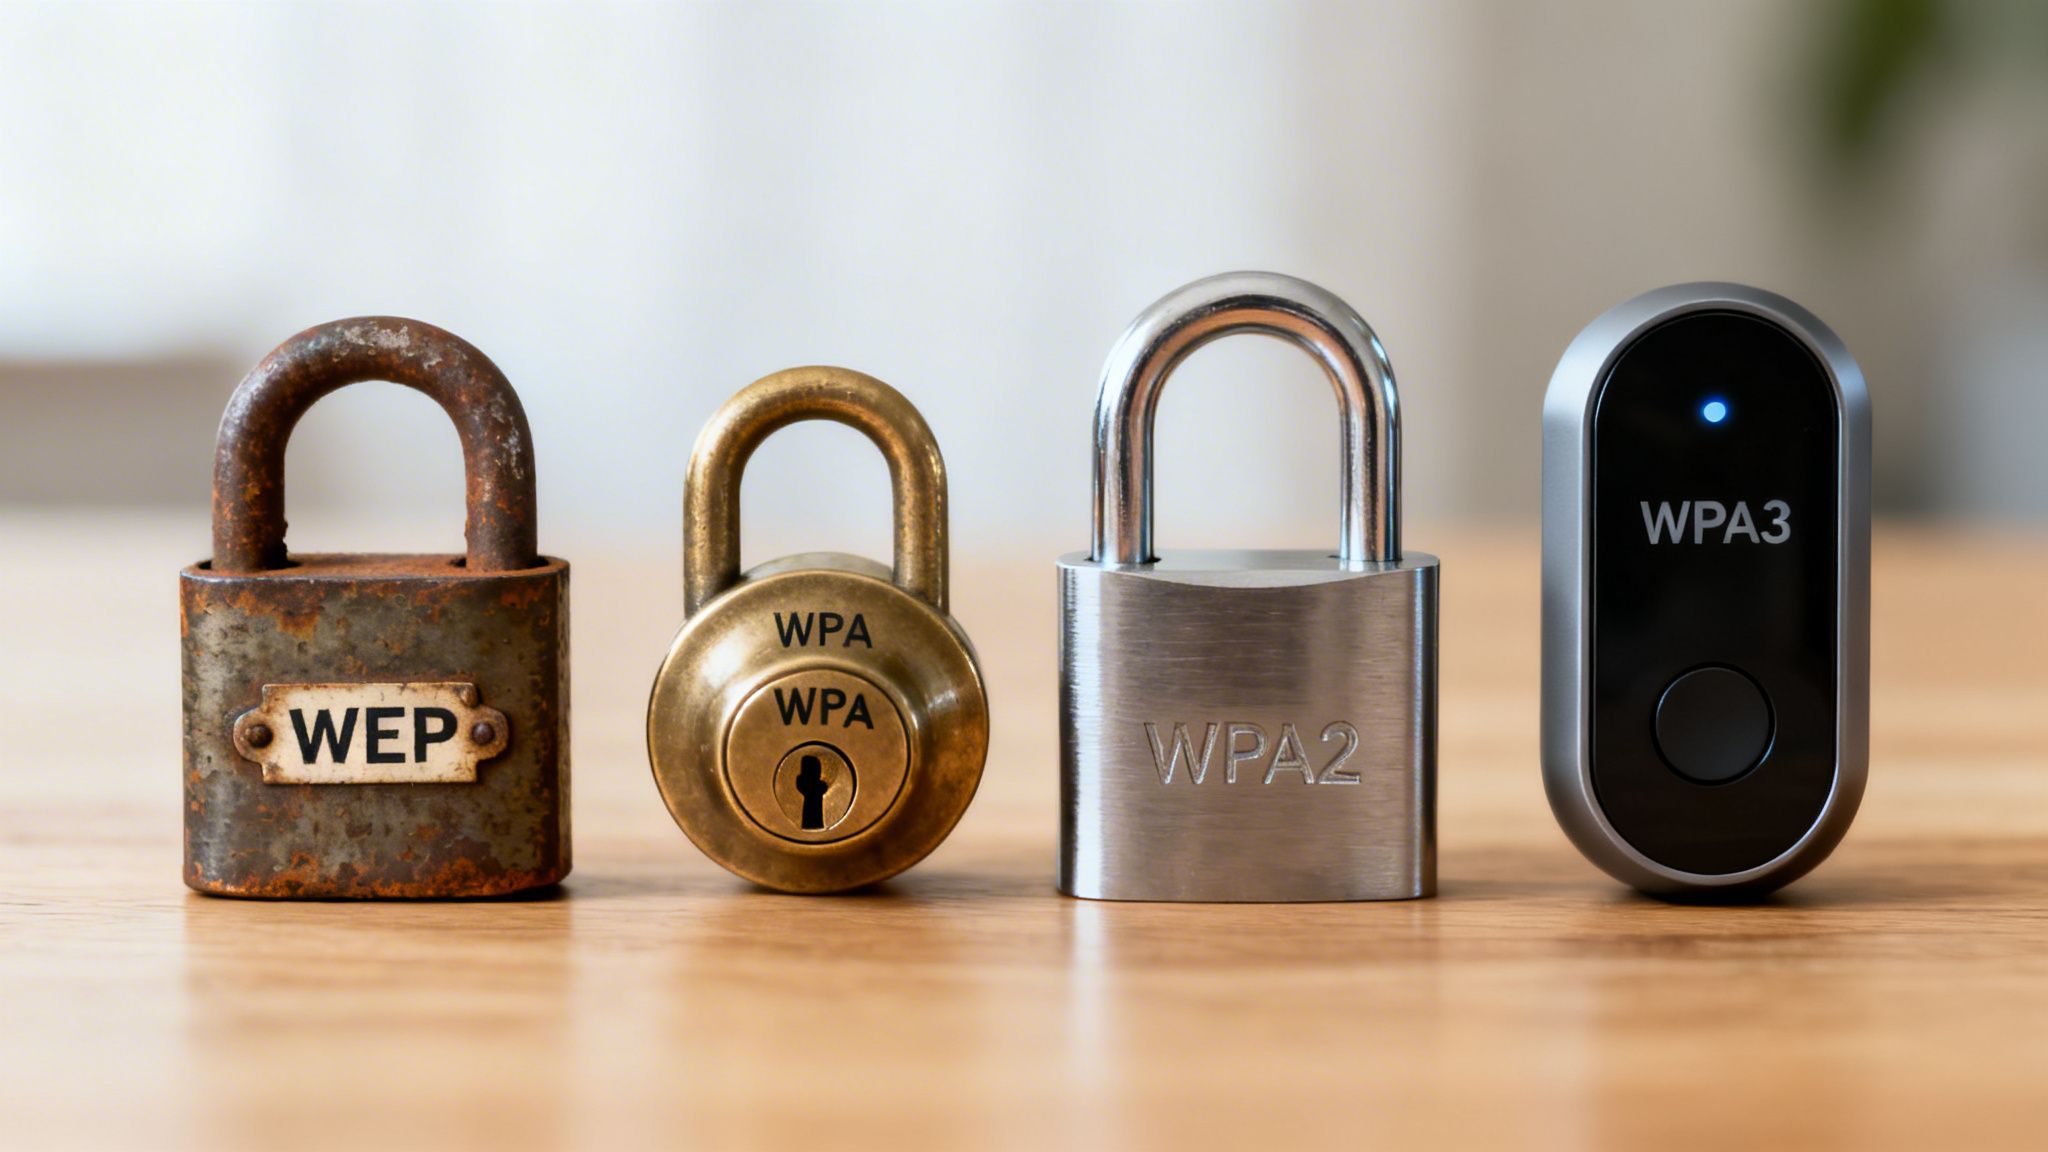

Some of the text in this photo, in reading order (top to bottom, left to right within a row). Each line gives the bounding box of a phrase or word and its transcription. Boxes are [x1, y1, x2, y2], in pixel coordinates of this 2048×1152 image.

[1640, 499, 1791, 545] WPA3
[773, 611, 872, 649] WPA
[774, 687, 874, 730] WPA
[289, 707, 458, 764] WEP
[1144, 721, 1361, 785] WPA2
